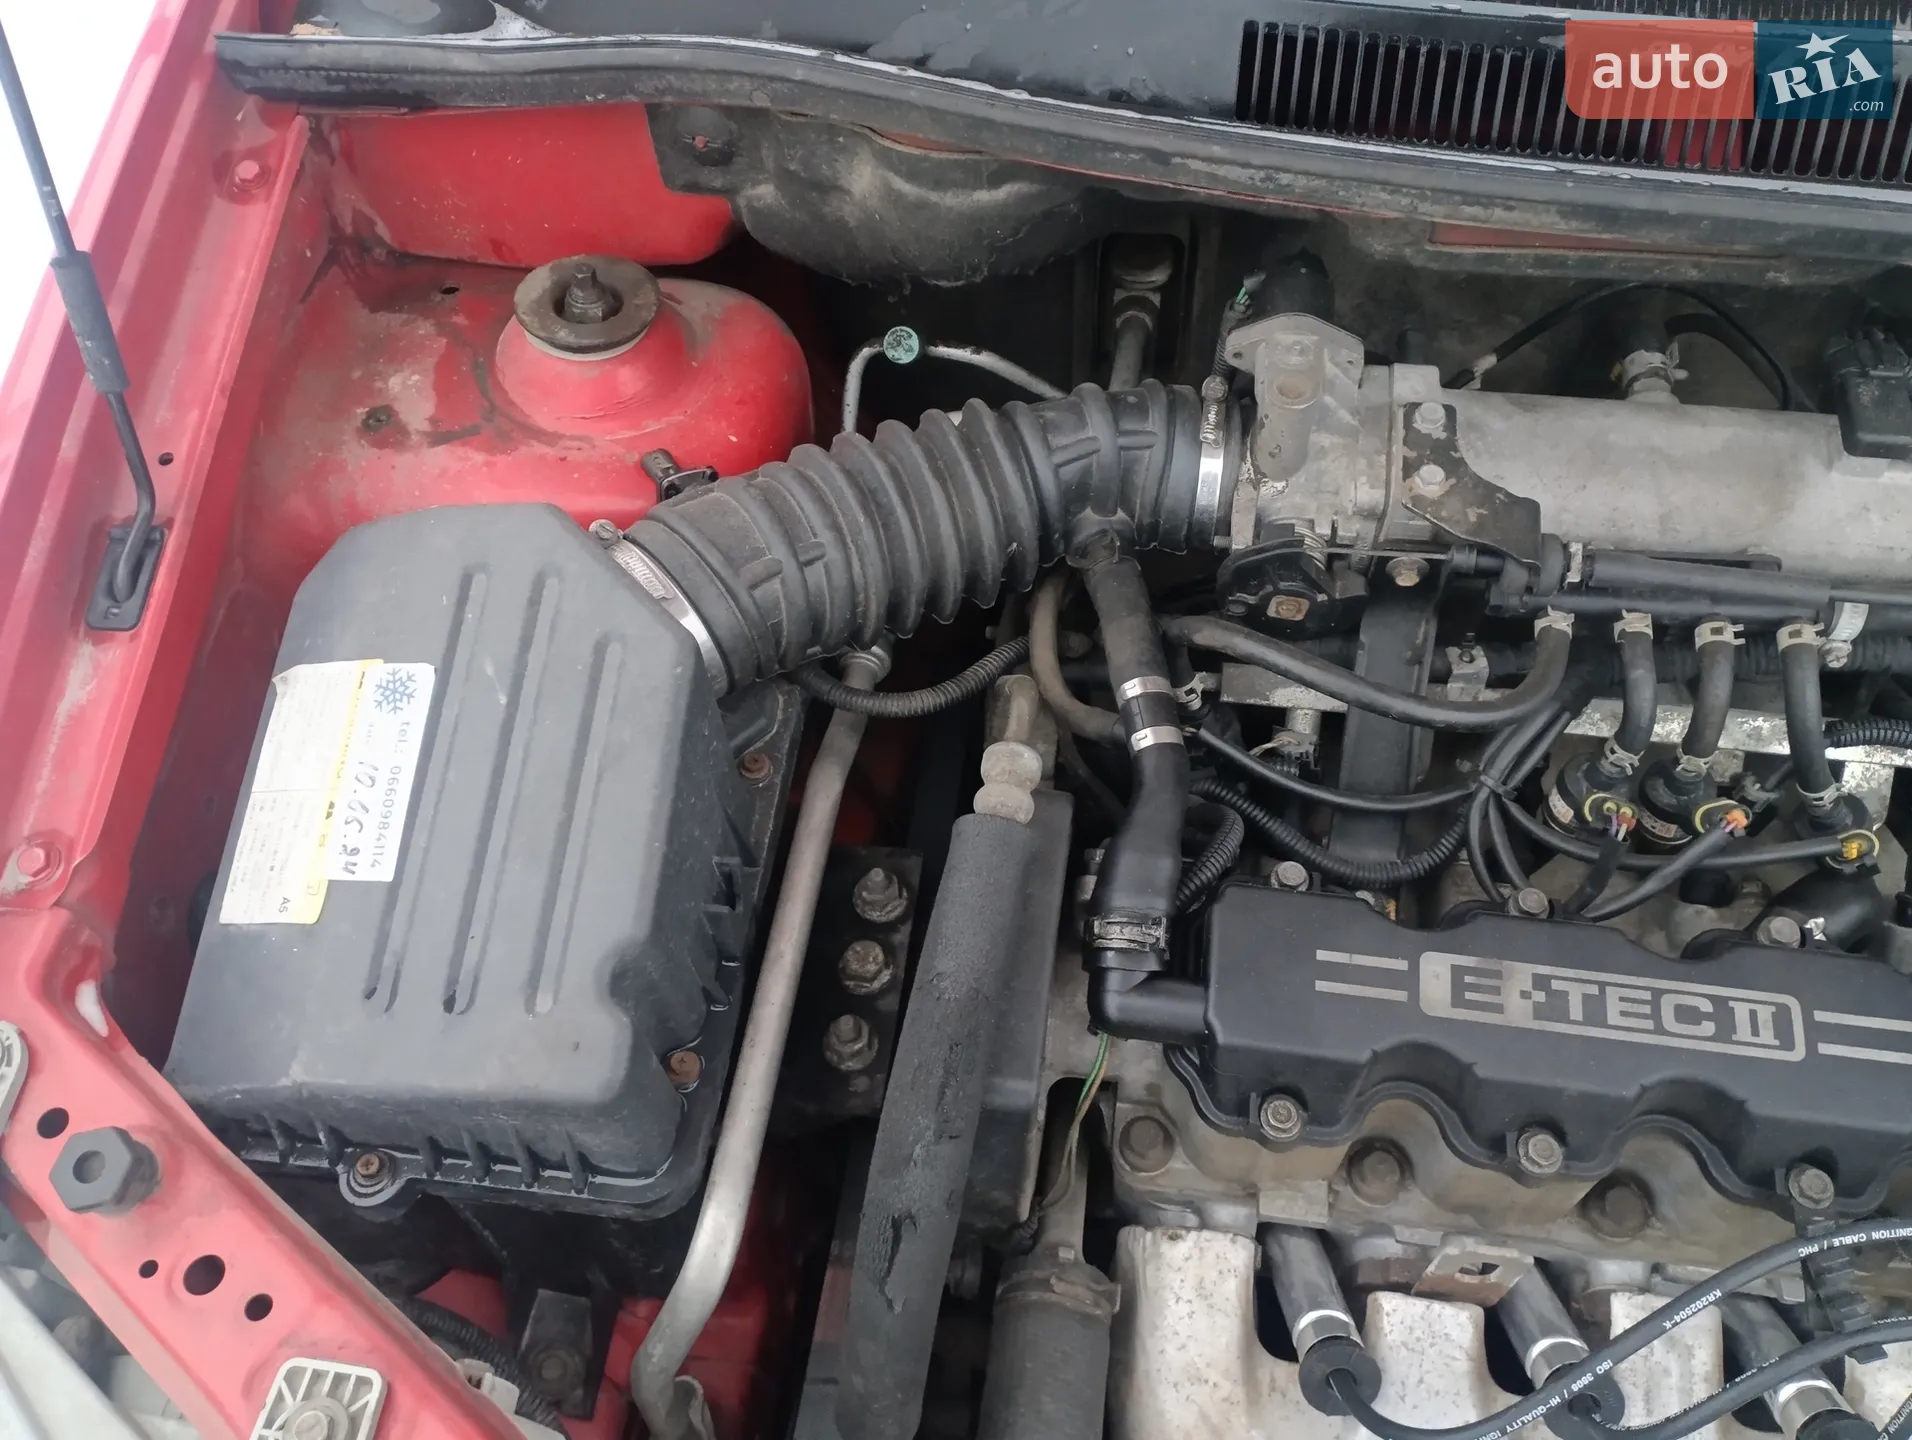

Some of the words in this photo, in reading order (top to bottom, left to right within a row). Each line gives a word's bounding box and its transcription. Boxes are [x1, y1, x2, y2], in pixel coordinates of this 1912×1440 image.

[278, 896, 292, 914] A5
[1832, 1233, 1867, 1248] CABLE
[1798, 1243, 1820, 1258] PHC
[1663, 1288, 1722, 1331] KR202504-K
[1595, 1359, 1614, 1375] ISO
[1505, 1394, 1562, 1433] HI-QUALITY
